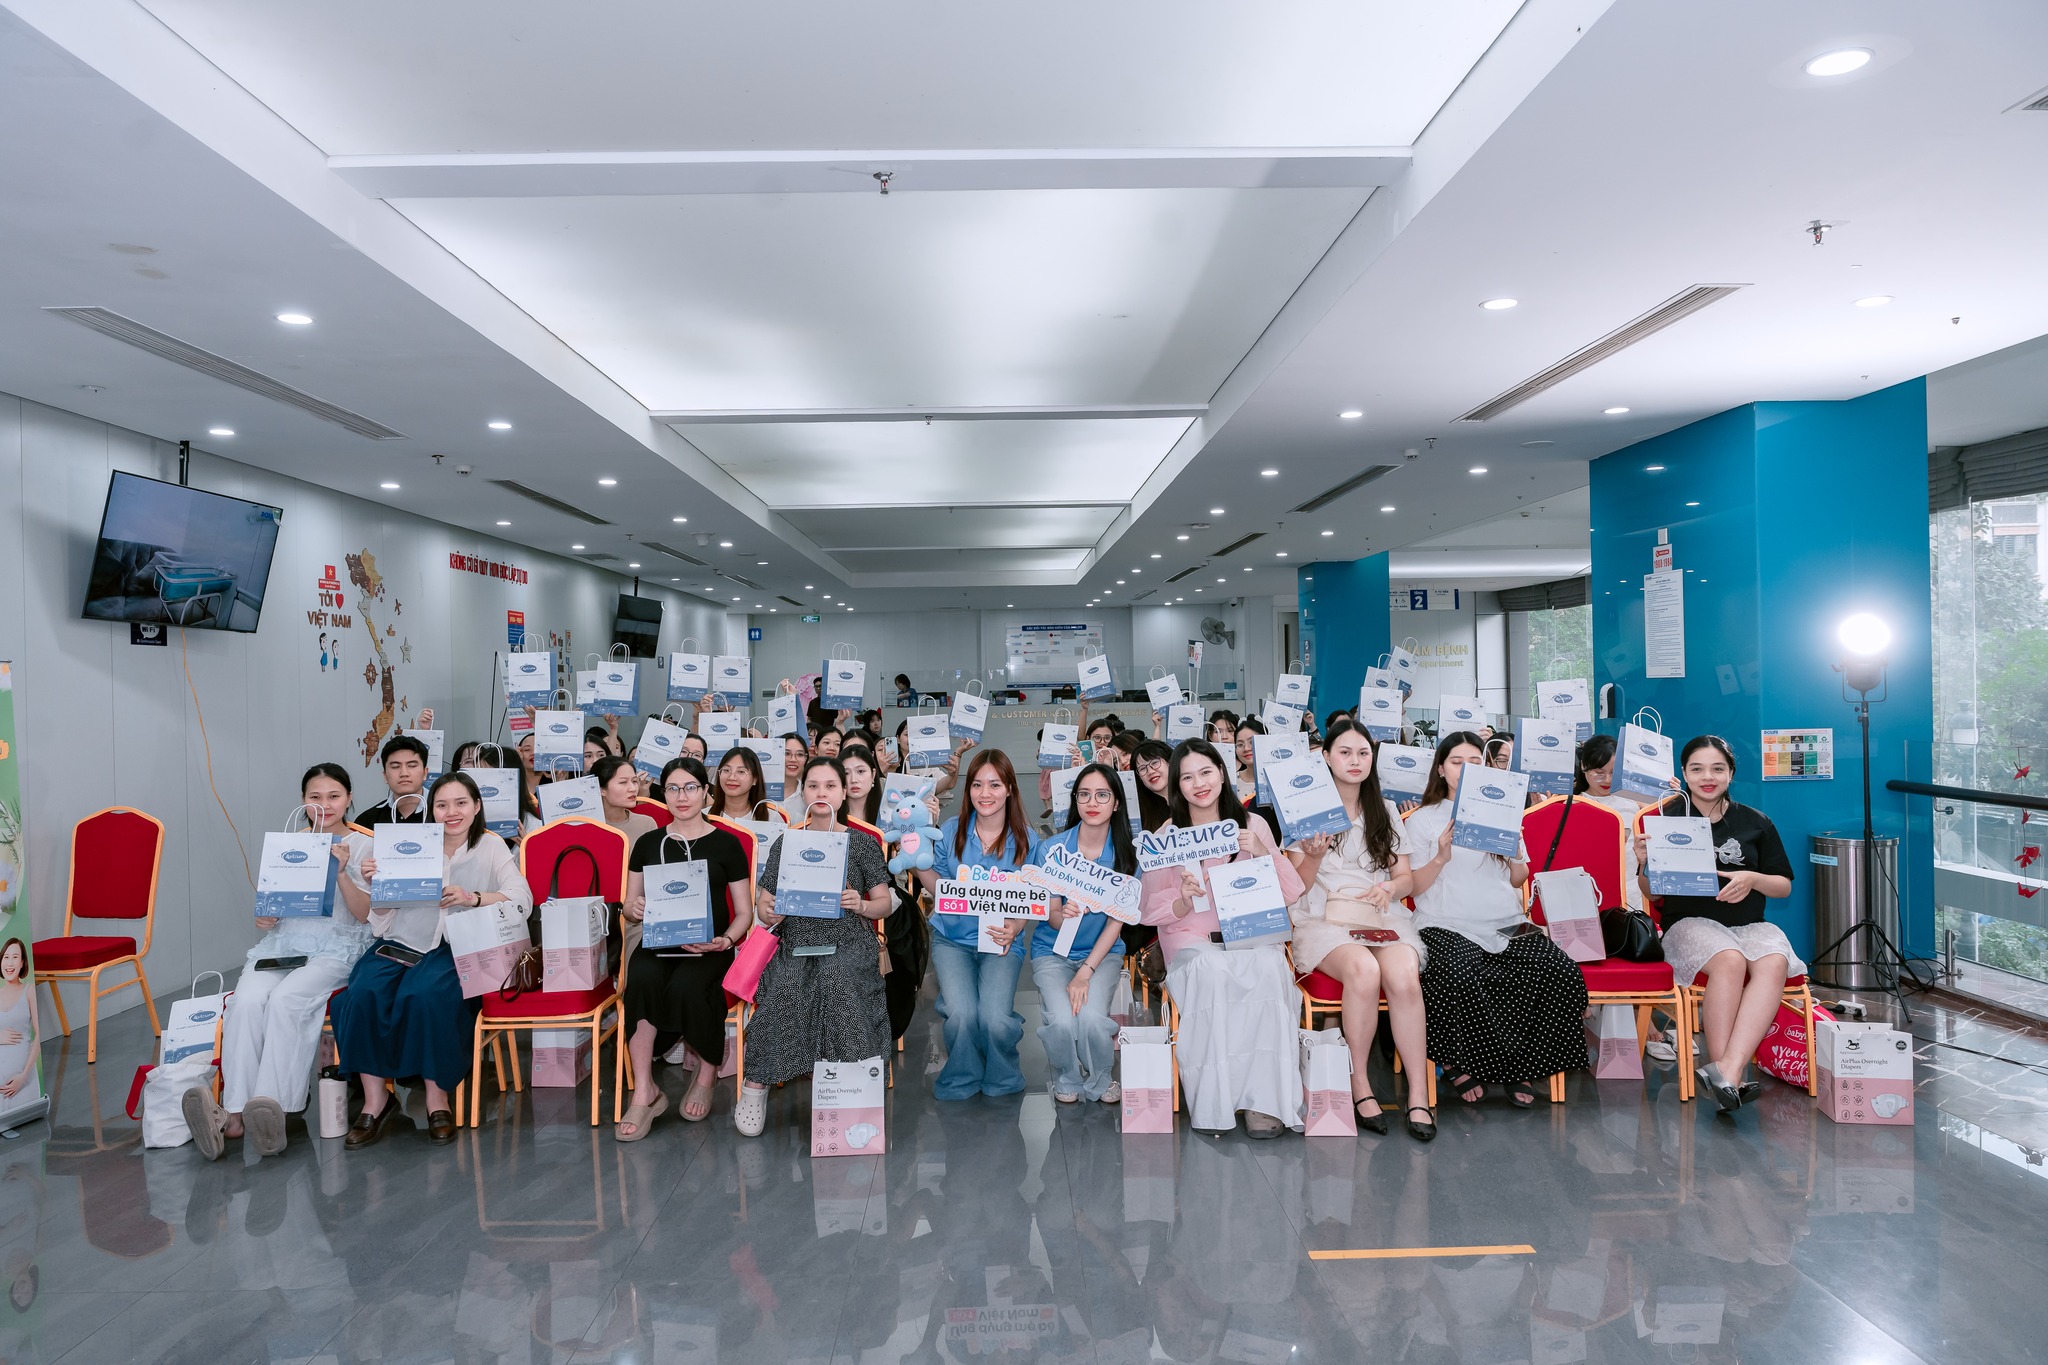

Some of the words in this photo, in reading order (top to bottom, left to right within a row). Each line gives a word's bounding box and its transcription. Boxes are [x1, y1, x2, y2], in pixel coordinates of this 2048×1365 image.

[450, 550, 466, 571] KHÔNG
[467, 554, 473, 572] CÓ
[480, 558, 488, 576] QUÝ
[319, 590, 333, 607] TÔI
[1414, 596, 1423, 608] 2
[307, 609, 328, 629] VIỆT
[332, 614, 351, 628] NAM
[1436, 642, 1468, 658] BỆNH
[1002, 710, 1046, 718] CUSTOMER
[1138, 822, 1235, 856] Avisure
[1143, 861, 1149, 869] VI
[1150, 856, 1164, 867] CHẤT
[1165, 852, 1176, 864] THẾ
[1177, 852, 1185, 862] HỆ
[1186, 851, 1198, 860] MỚI
[1199, 849, 1210, 858] CHO
[1211, 847, 1220, 856] MẸ
[1220, 843, 1229, 852] VÀ
[1229, 841, 1237, 850] BÉ
[1049, 846, 1123, 887] Avisure
[972, 867, 1022, 883] Beberi
[940, 882, 966, 898] Ứng
[969, 886, 1002, 900] dụng
[1006, 890, 1026, 902] mẹ
[1030, 890, 1046, 901] bé
[1076, 880, 1083, 888] VI
[944, 900, 957, 910] SỐ
[959, 903, 964, 911] 1
[969, 900, 996, 914] Việt
[1000, 902, 1030, 914] Nam
[1787, 1028, 1807, 1040] baby
[1779, 1045, 1800, 1058] Yêu
[1790, 1061, 1808, 1070] CH
